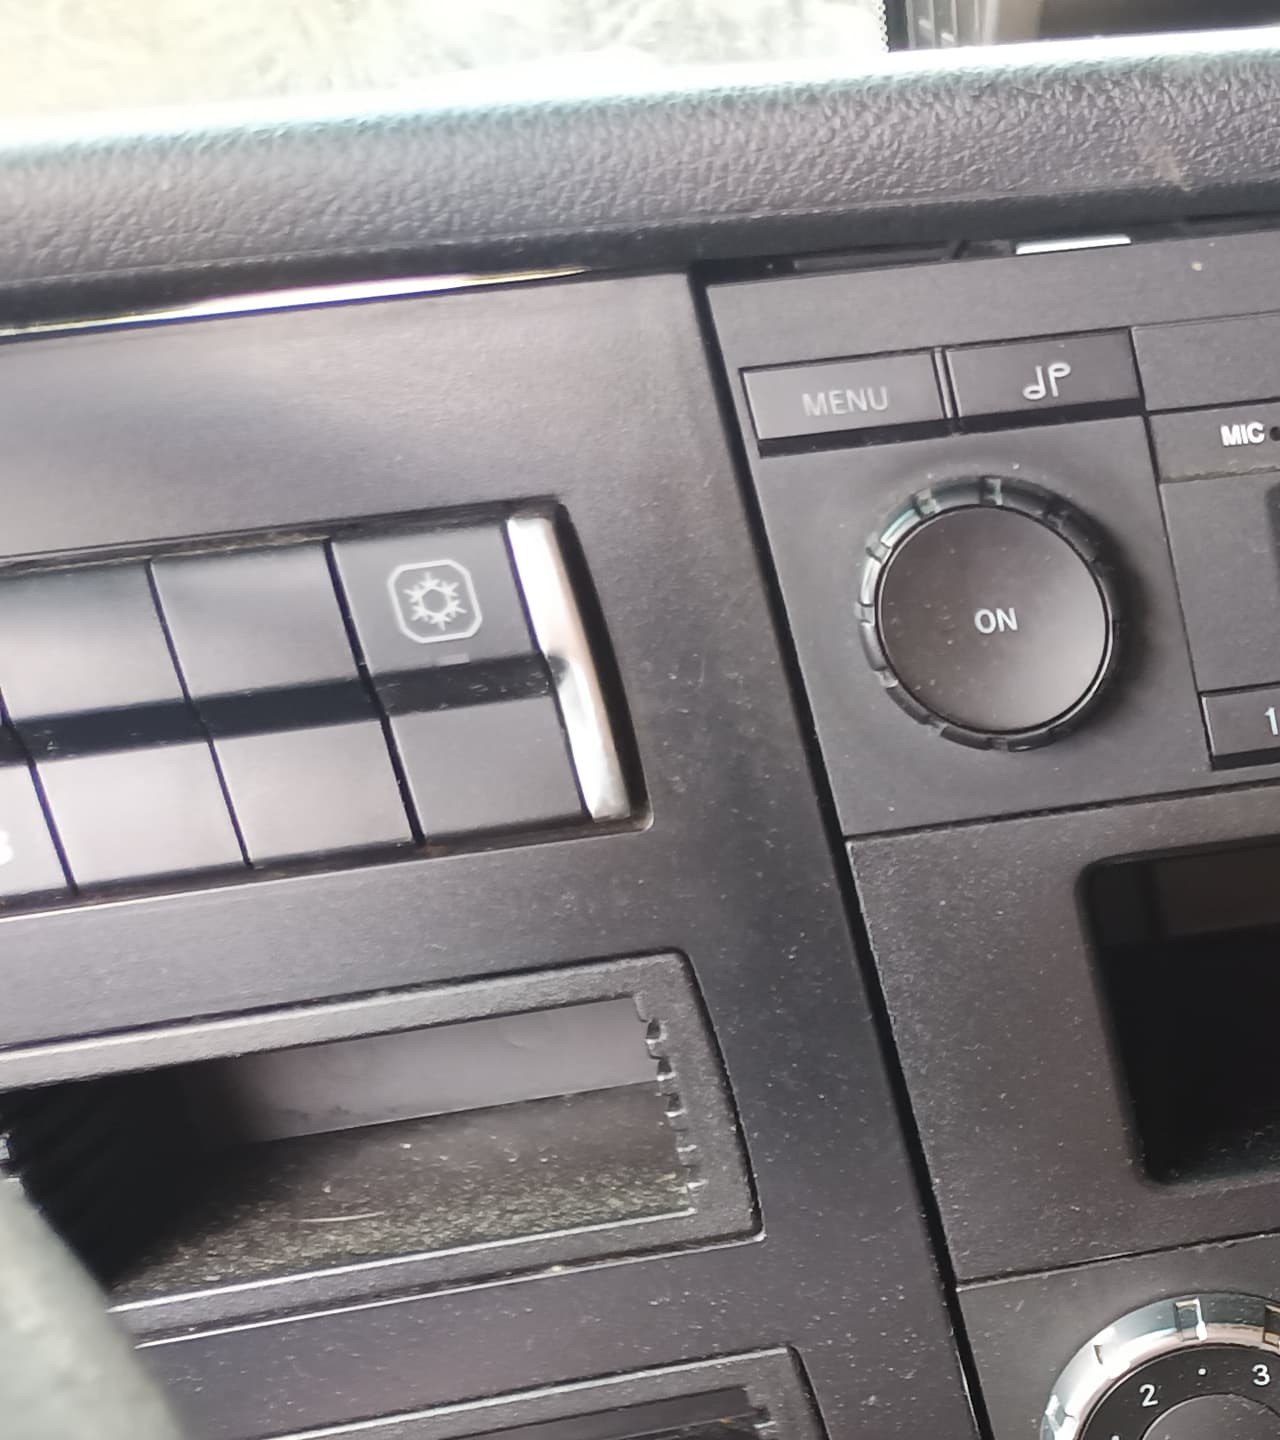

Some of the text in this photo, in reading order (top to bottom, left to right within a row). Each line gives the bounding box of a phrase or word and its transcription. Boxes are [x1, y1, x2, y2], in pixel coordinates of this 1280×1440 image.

[802, 387, 888, 417] MENU
[1221, 422, 1264, 446] MIC
[975, 608, 1018, 634] ON
[1265, 708, 1279, 736] 1
[1252, 1364, 1270, 1386] 3
[1139, 1384, 1158, 1407] 2
